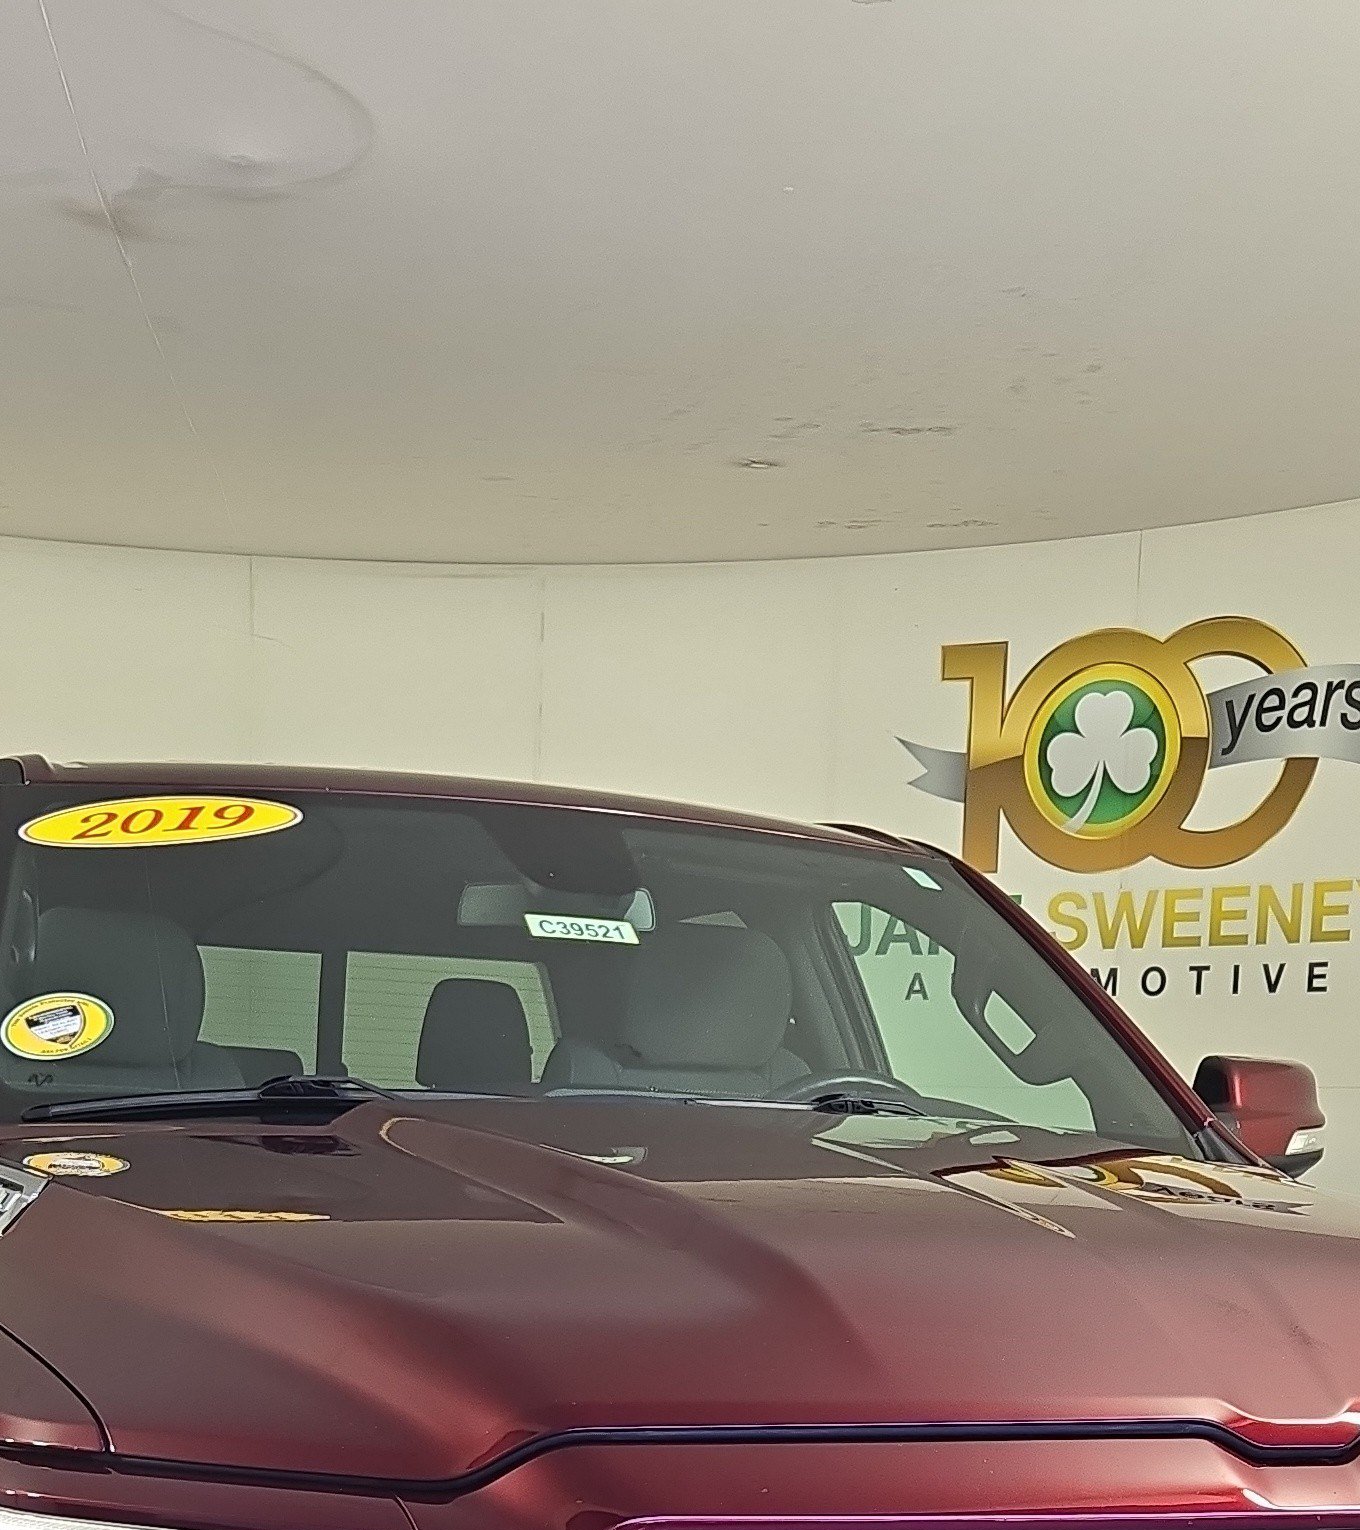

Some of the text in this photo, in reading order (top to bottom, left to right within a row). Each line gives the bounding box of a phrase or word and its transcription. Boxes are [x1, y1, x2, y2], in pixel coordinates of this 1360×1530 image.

[942, 616, 1320, 873] 100
[71, 804, 255, 840] 2019
[539, 919, 626, 940] C39521
[905, 961, 1330, 1001] AMOTIVE
